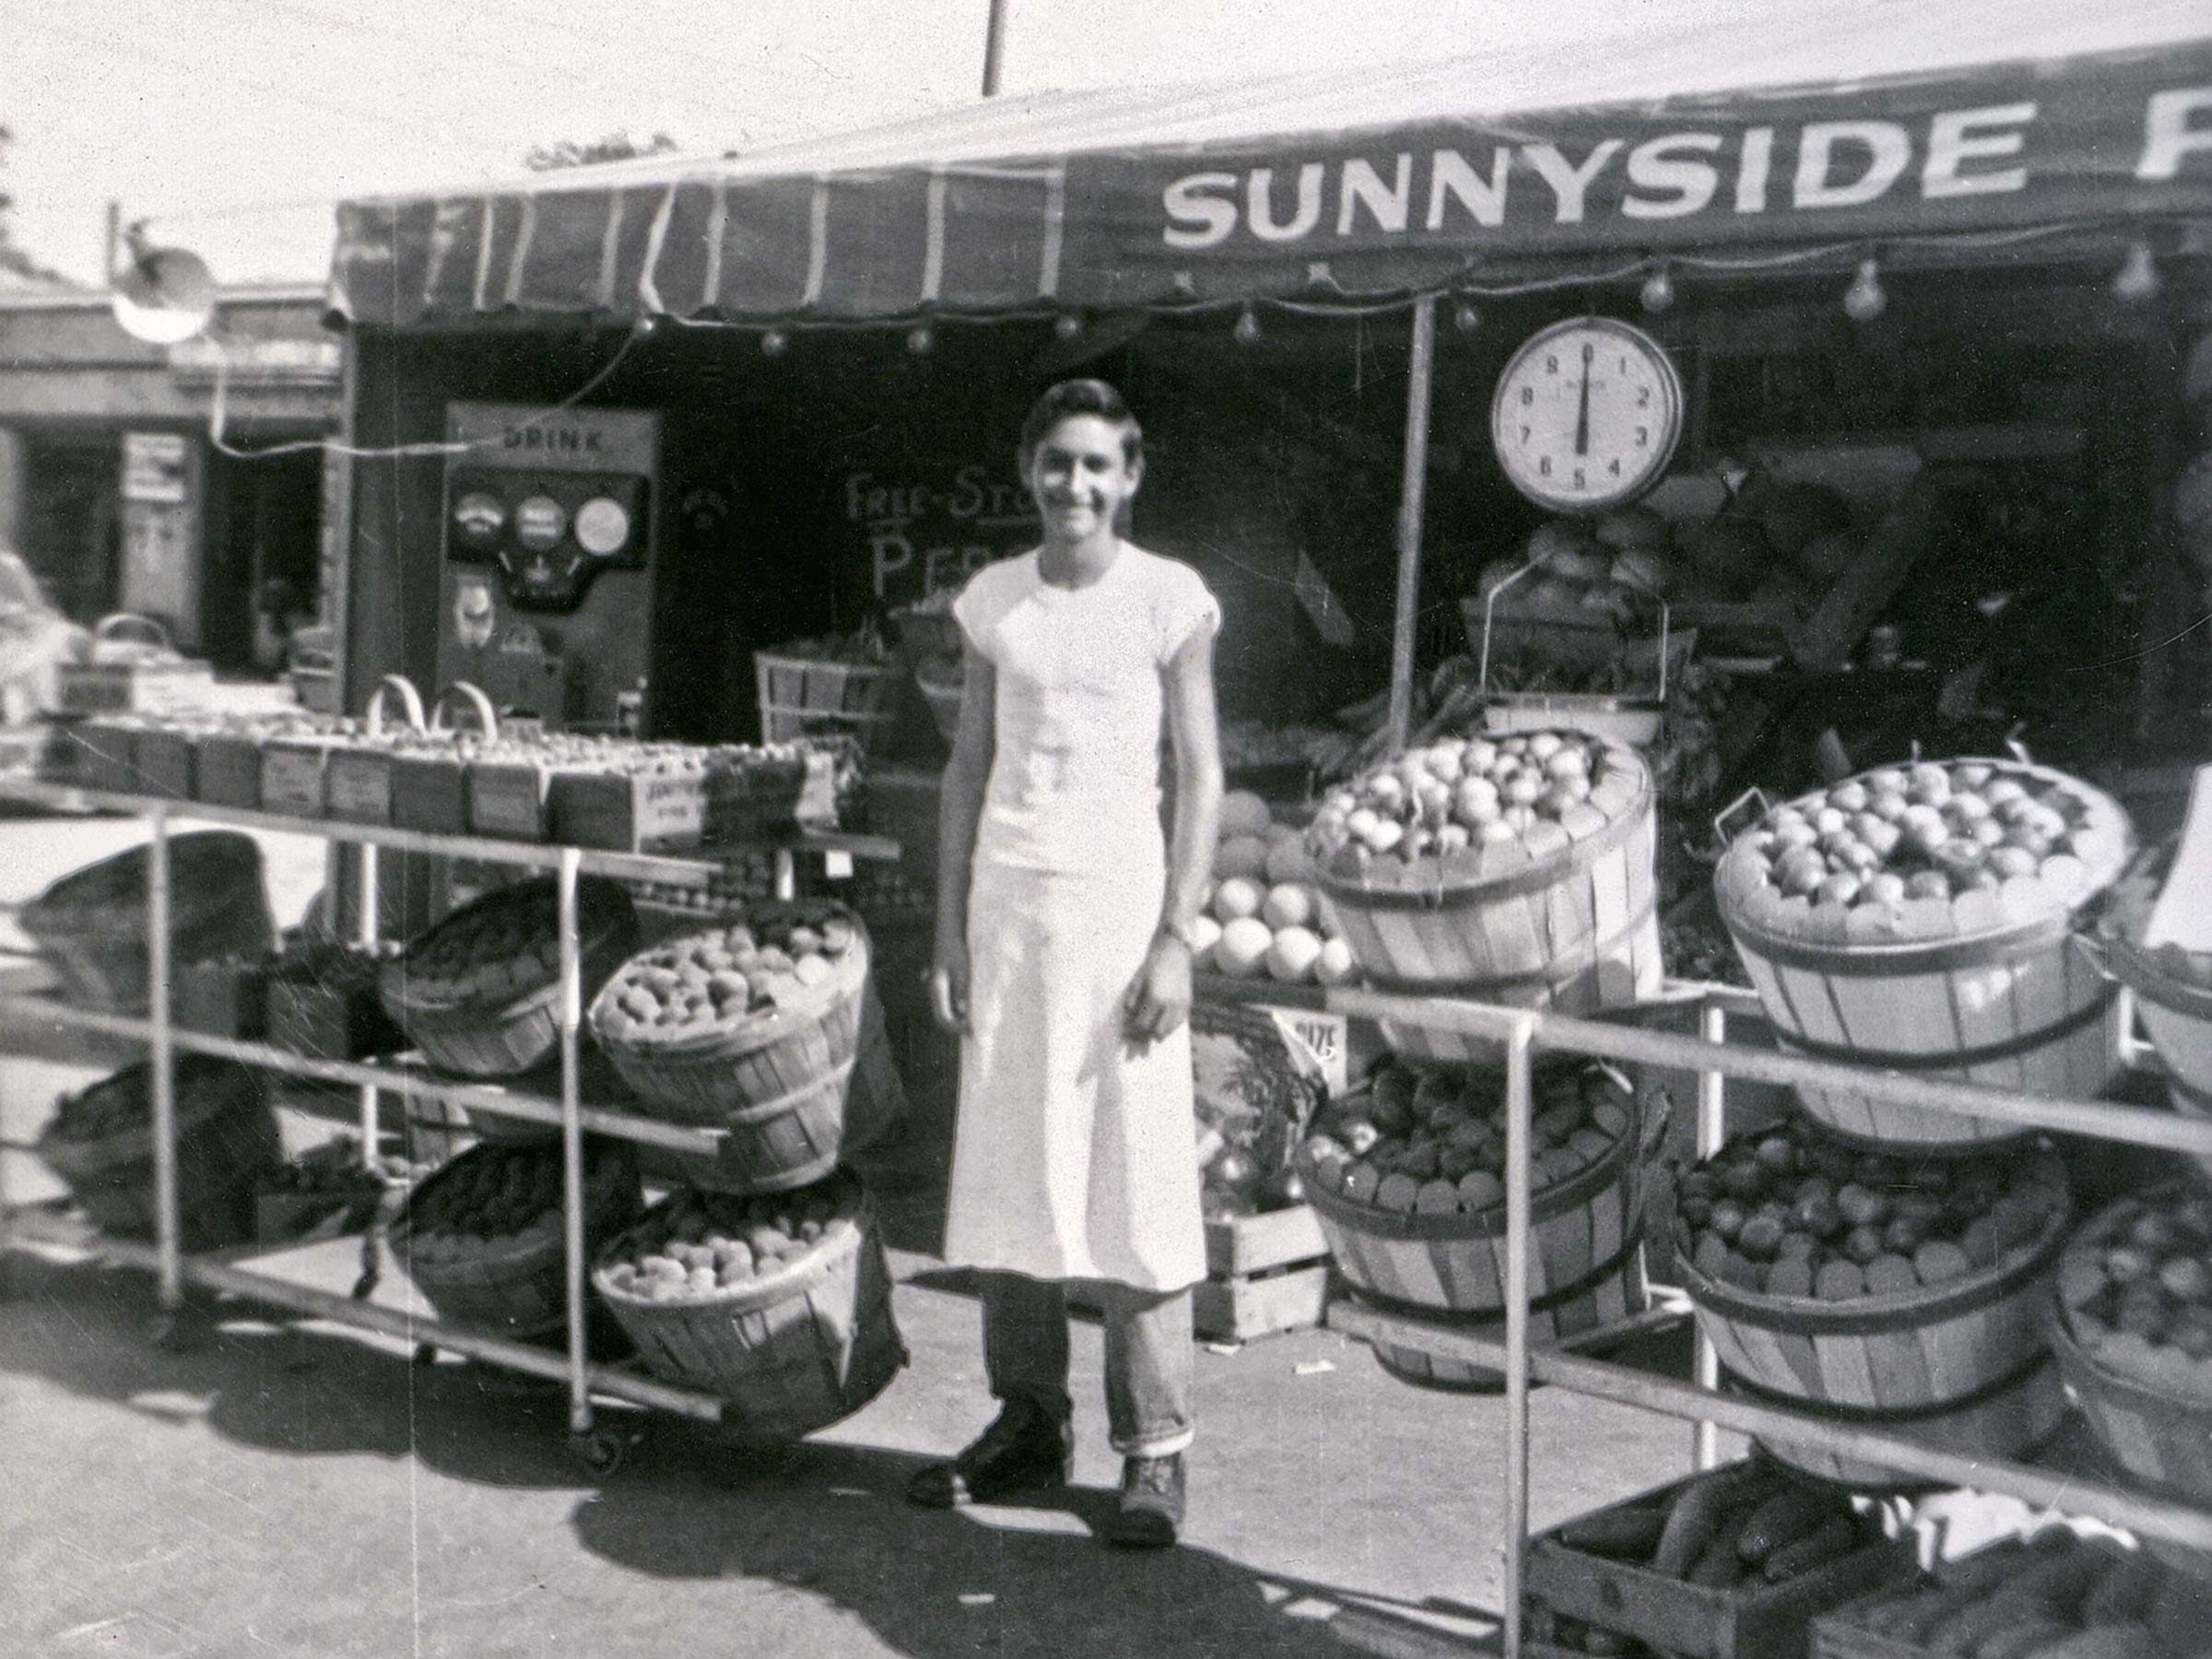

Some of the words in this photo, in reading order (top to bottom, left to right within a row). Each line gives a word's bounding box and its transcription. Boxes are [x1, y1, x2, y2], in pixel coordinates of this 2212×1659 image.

[1162, 101, 2038, 249] SUNNYSIDE
[1620, 357, 1627, 375] 1
[1522, 386, 1534, 406] 8
[1638, 386, 1650, 408] 2
[503, 426, 603, 452] DRINK
[1520, 426, 1531, 444] 7
[1635, 426, 1648, 447] 3
[1540, 455, 1551, 477] 6
[1608, 459, 1620, 478] 4
[1573, 468, 1585, 489] 5
